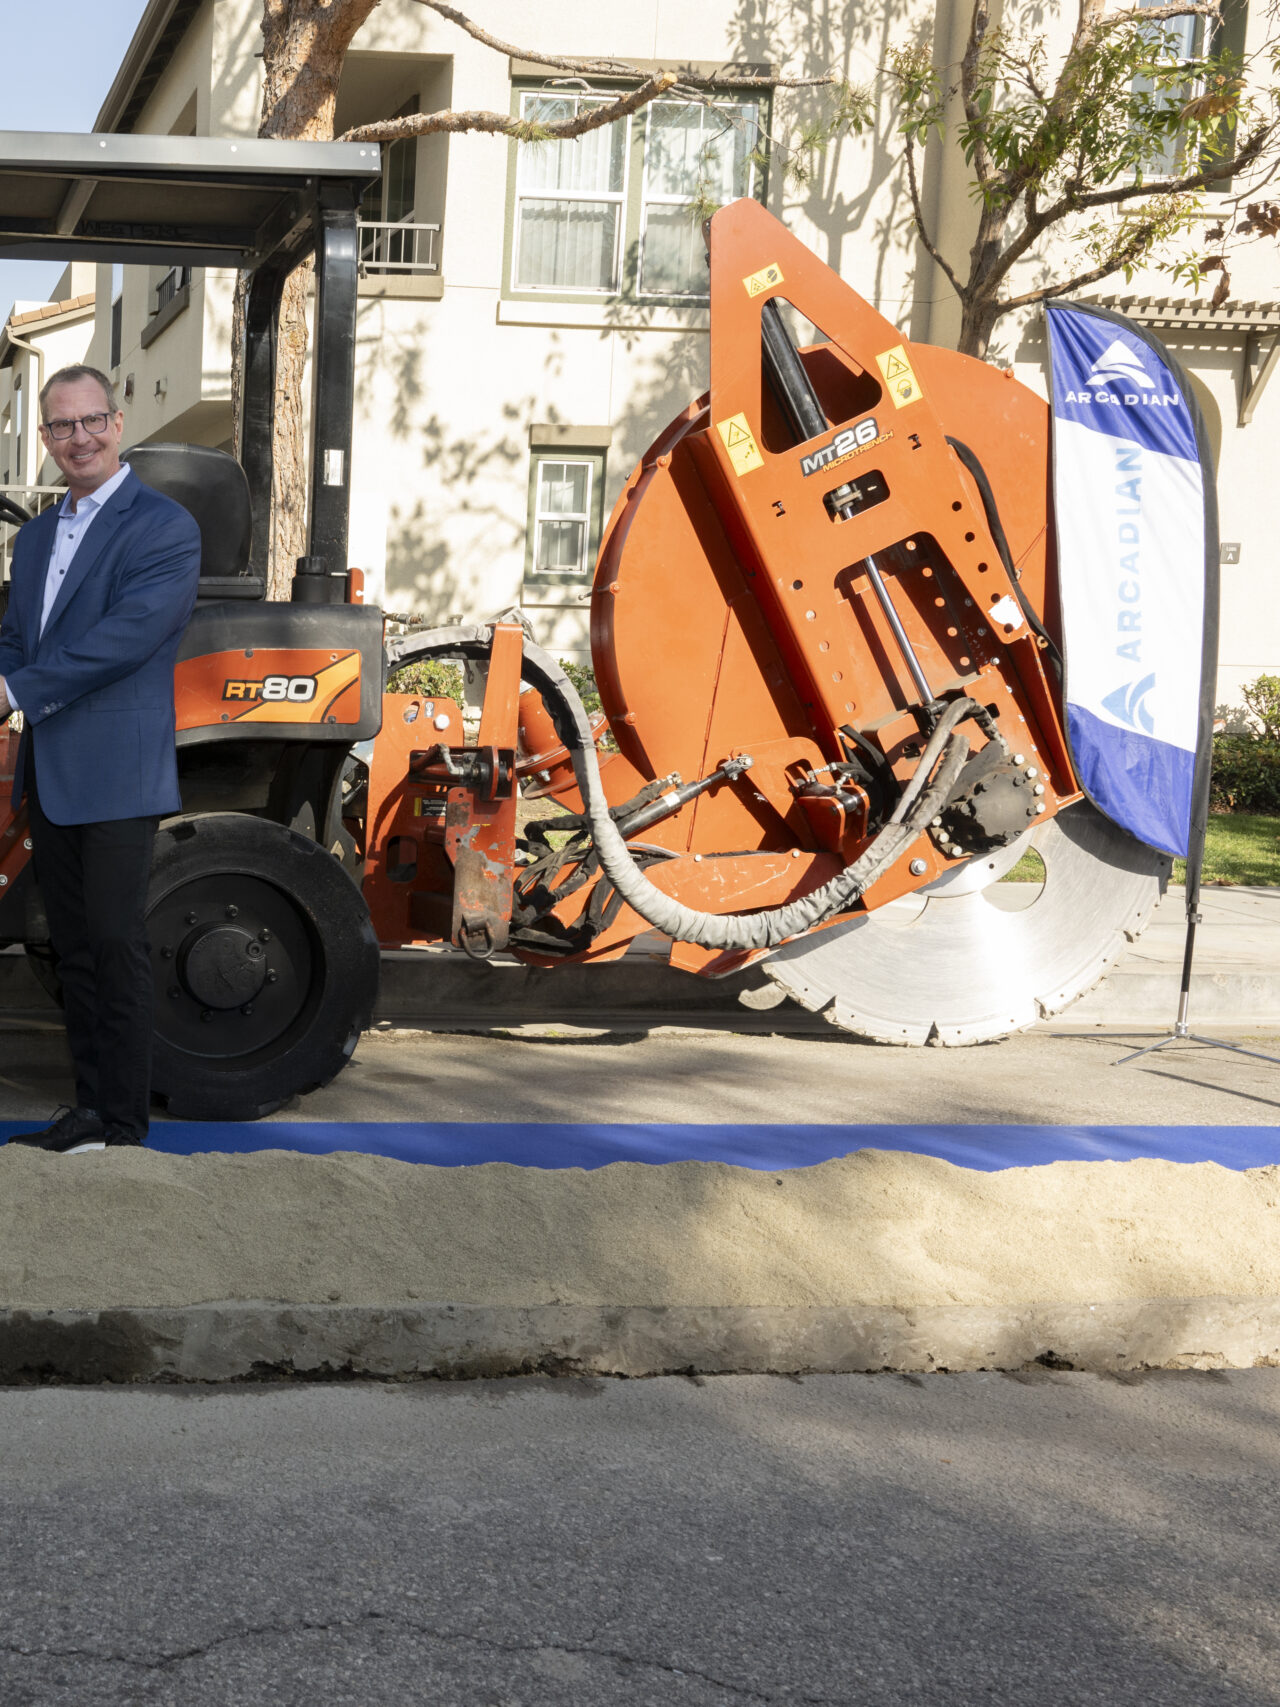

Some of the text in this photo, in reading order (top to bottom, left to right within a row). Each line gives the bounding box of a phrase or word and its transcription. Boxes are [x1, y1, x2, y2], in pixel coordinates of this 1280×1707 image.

[1065, 390, 1179, 406] ARCADIAN
[802, 419, 878, 475] MT26
[822, 430, 894, 473] MICROTRENCH
[1115, 448, 1143, 663] ARCADIAN
[225, 677, 315, 701] RT80
